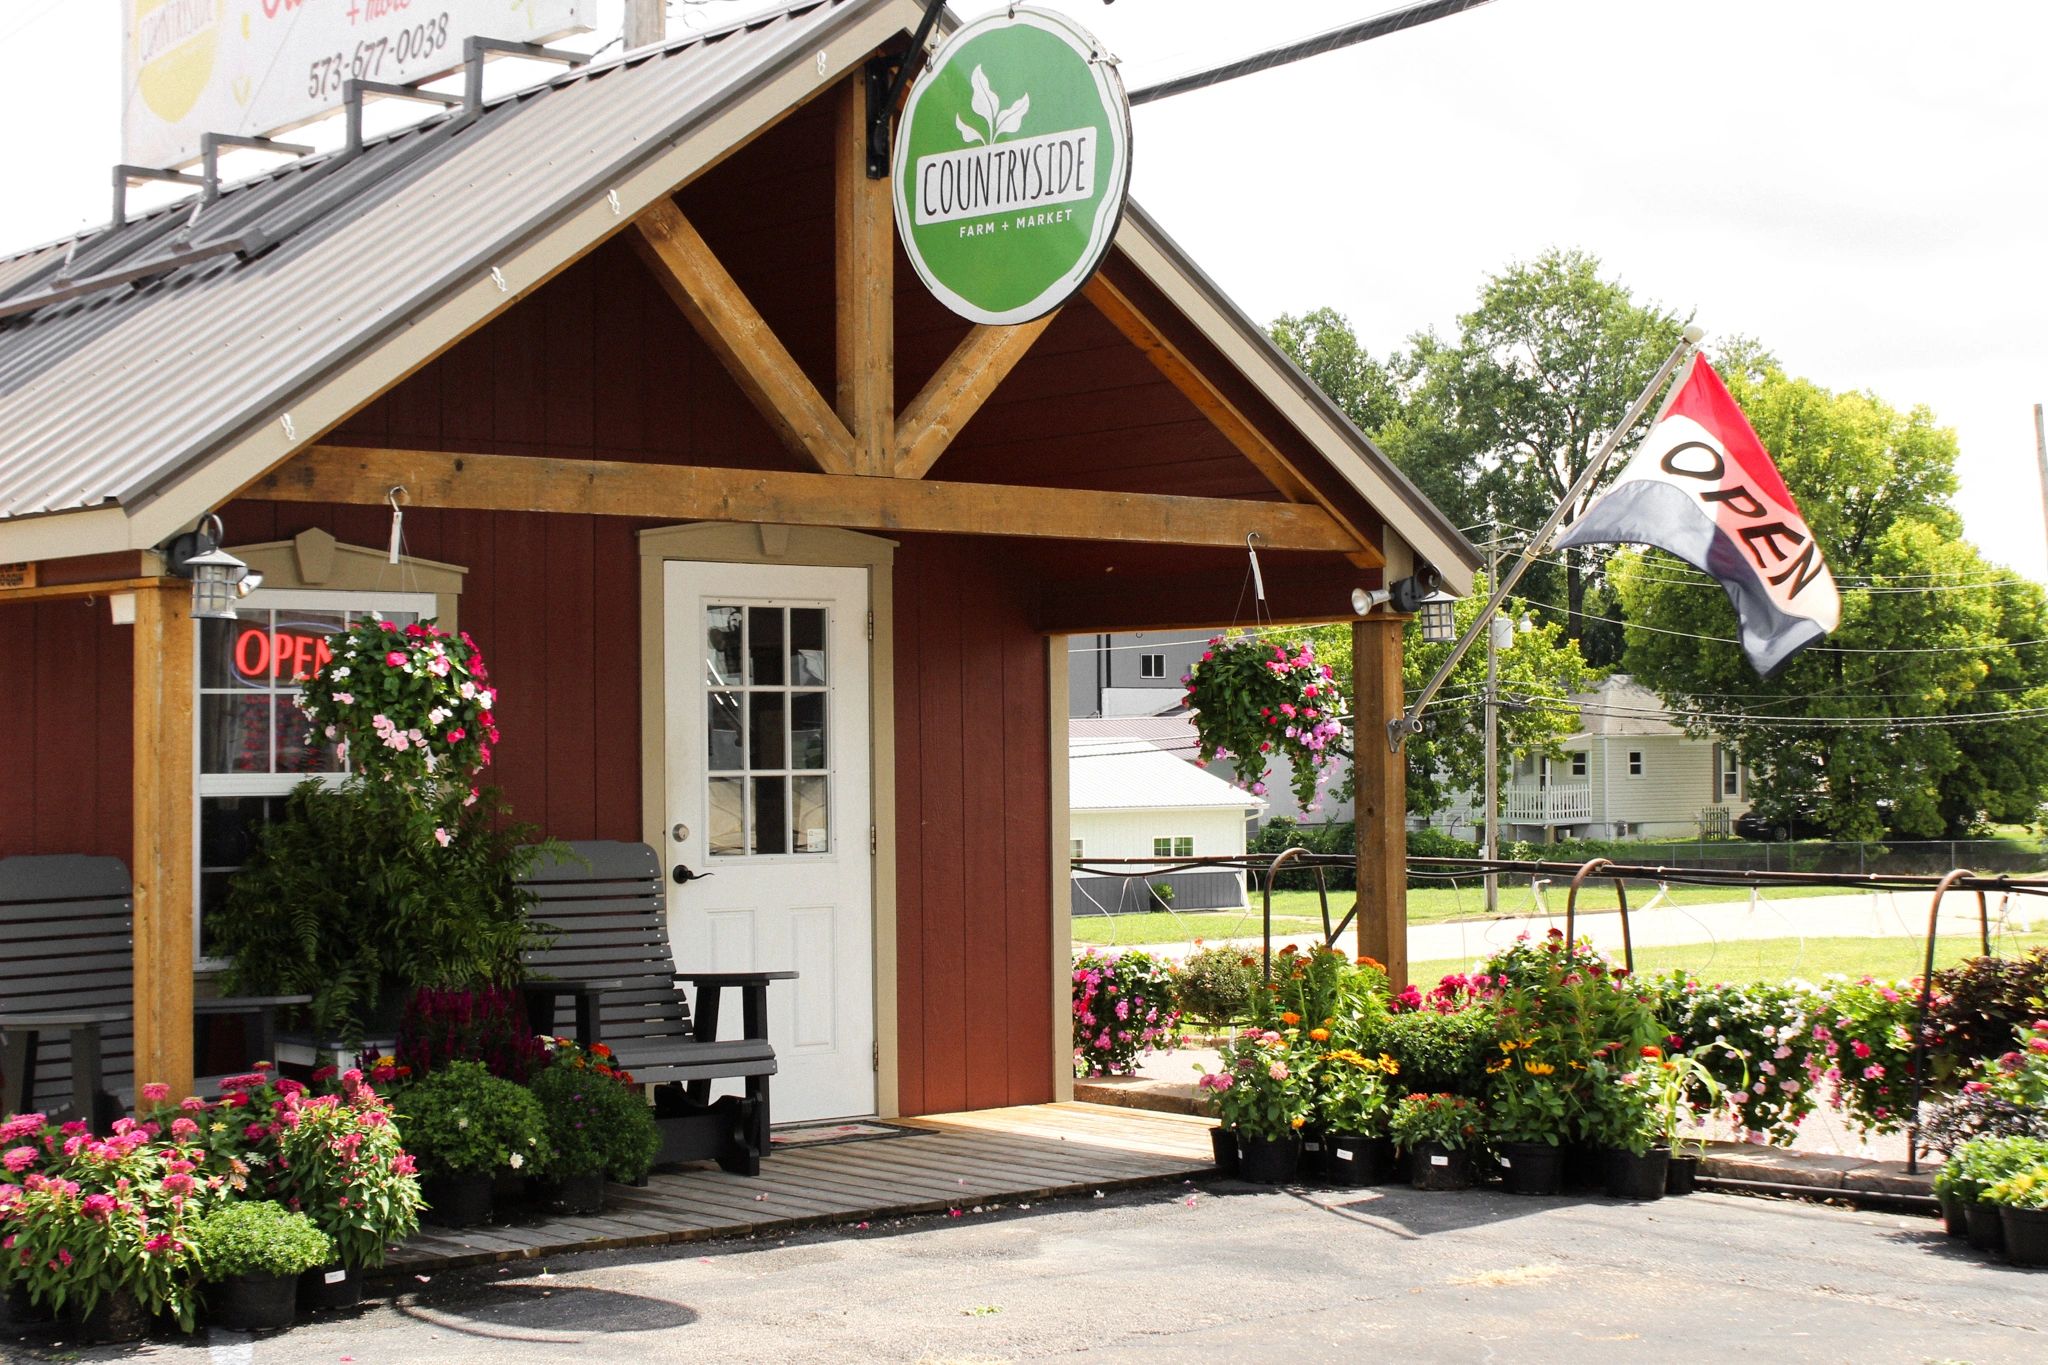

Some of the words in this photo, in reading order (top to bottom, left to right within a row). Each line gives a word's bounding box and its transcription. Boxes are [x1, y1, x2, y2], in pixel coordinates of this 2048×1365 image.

[308, 12, 449, 99] 573-677-0038
[923, 137, 1087, 216] COUNTRYSIDE
[959, 222, 995, 238] FARM
[1016, 209, 1073, 229] MARKET
[1660, 441, 1825, 601] OPEN
